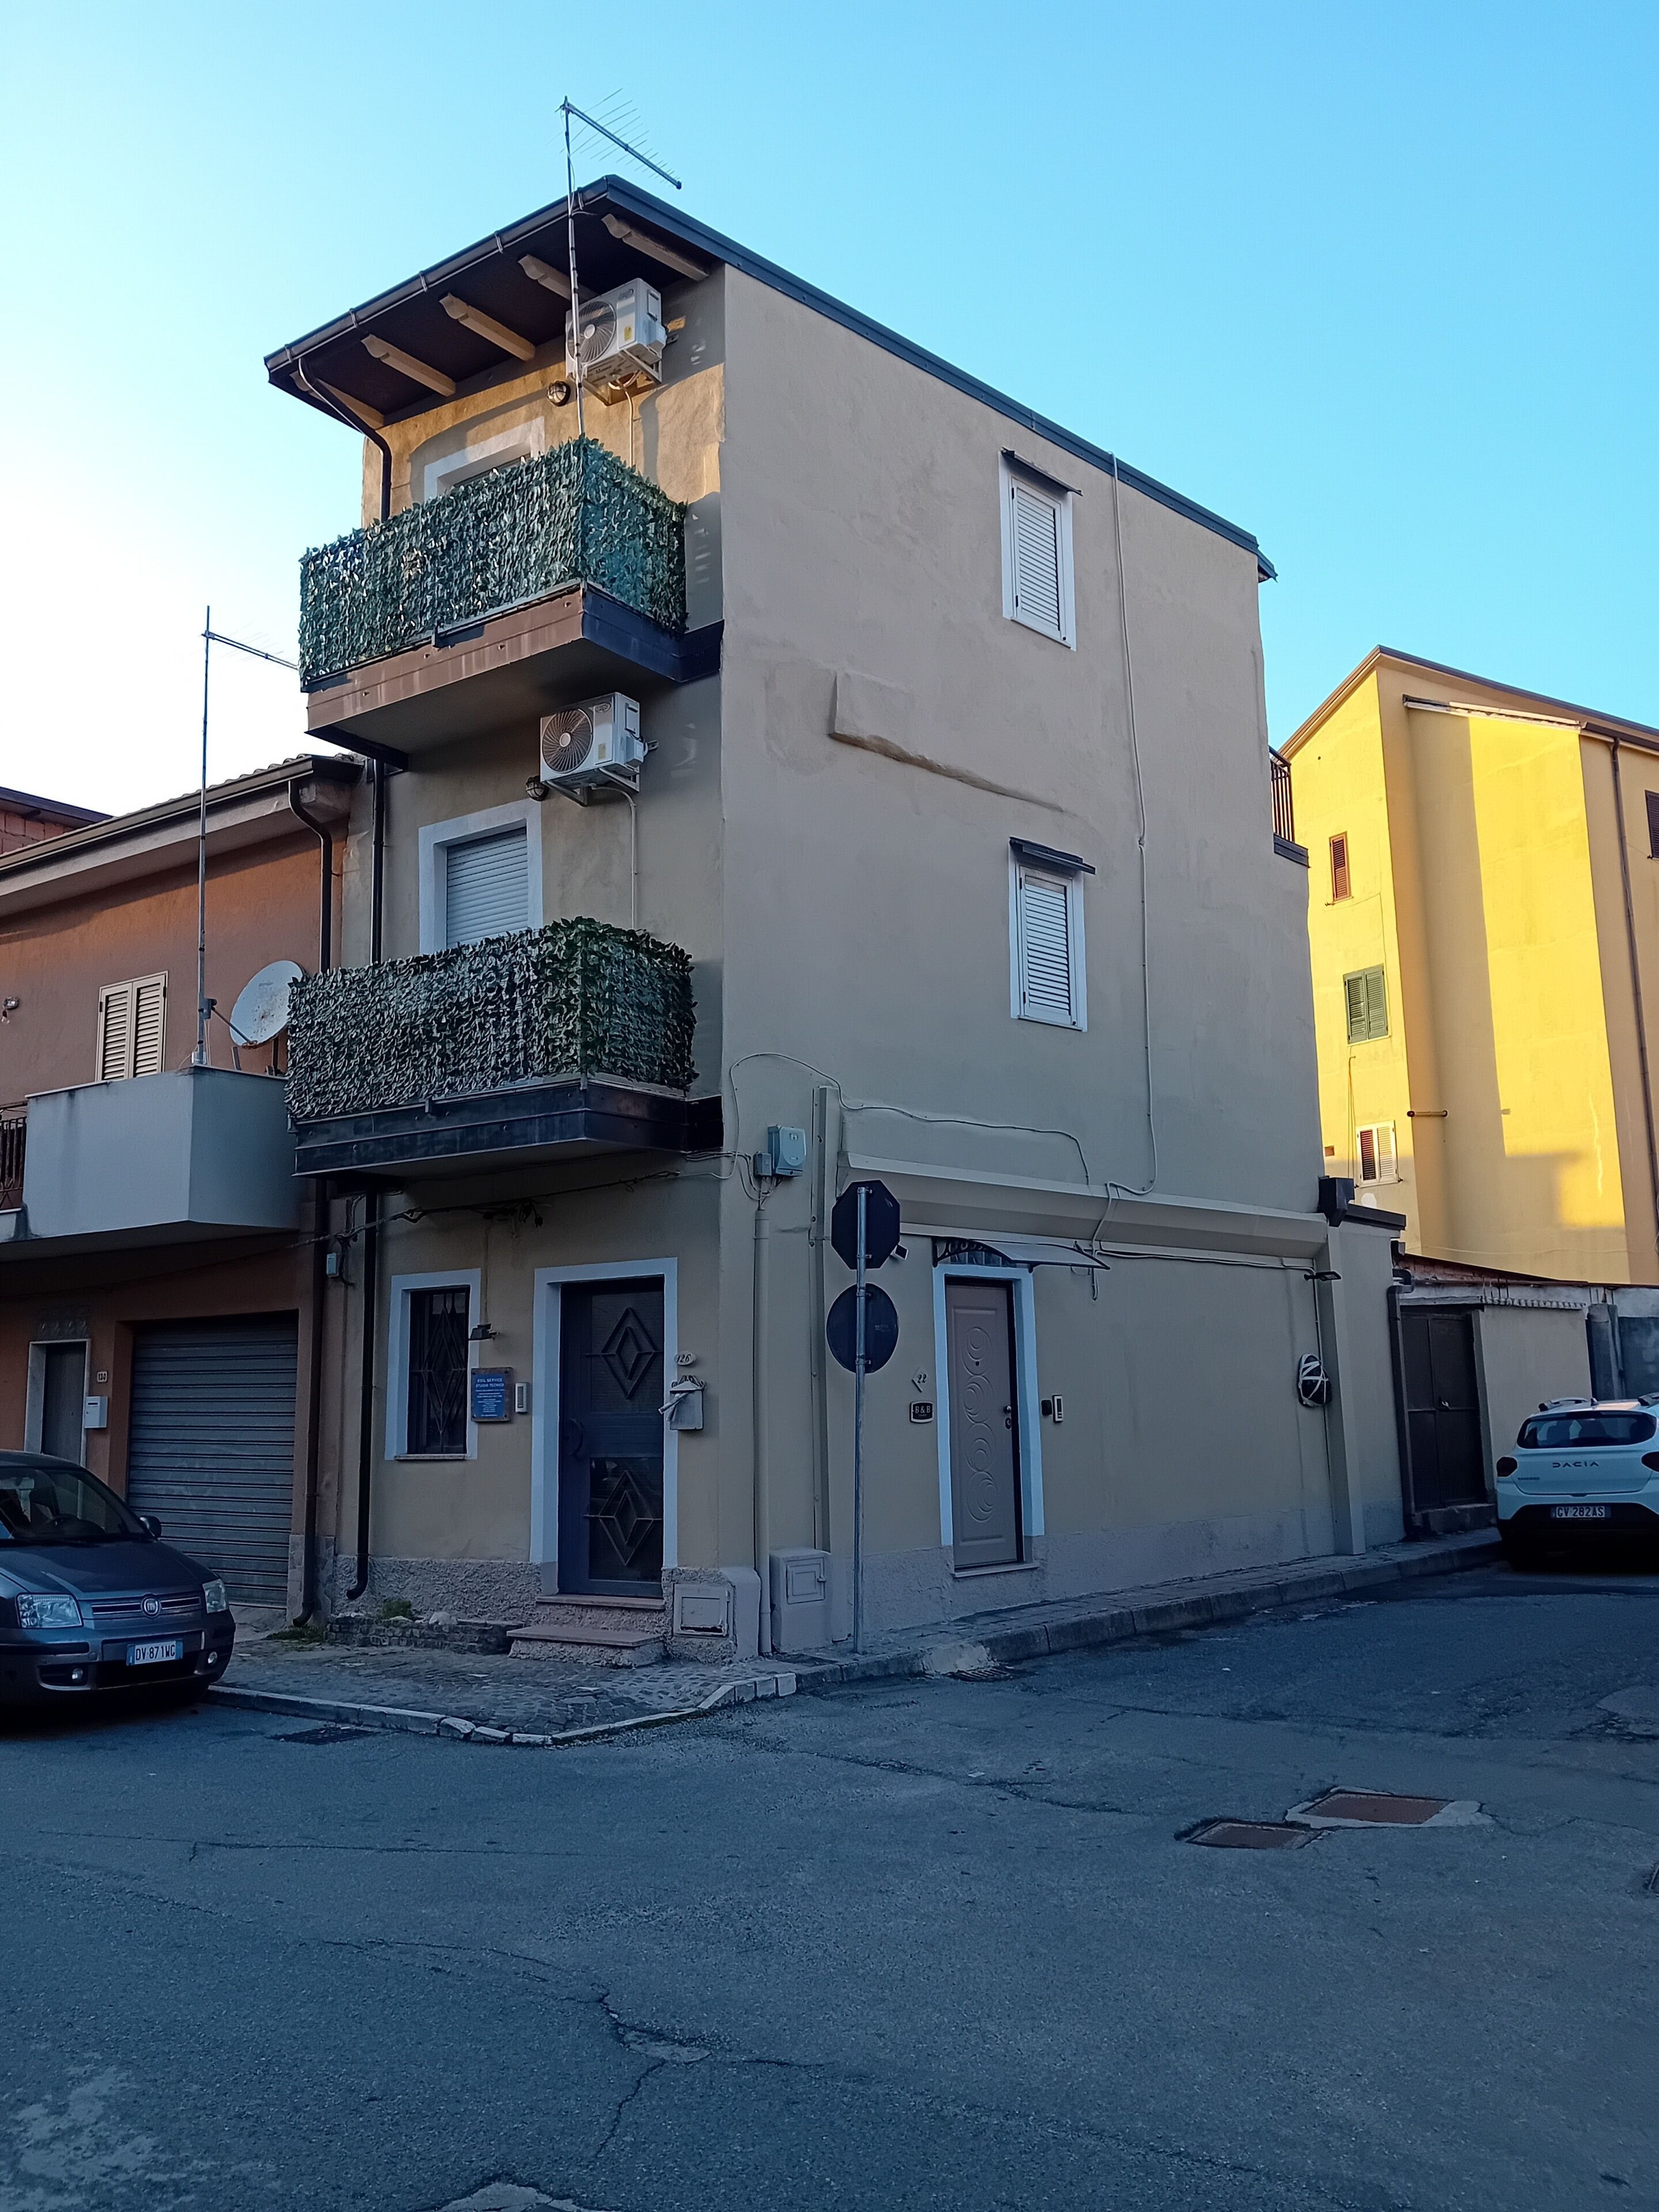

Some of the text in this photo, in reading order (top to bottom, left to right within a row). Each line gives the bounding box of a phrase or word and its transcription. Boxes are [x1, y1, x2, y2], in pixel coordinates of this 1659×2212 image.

[676, 1354, 691, 1363] 126
[917, 1373, 927, 1384] 22
[135, 1647, 147, 1661] DV
